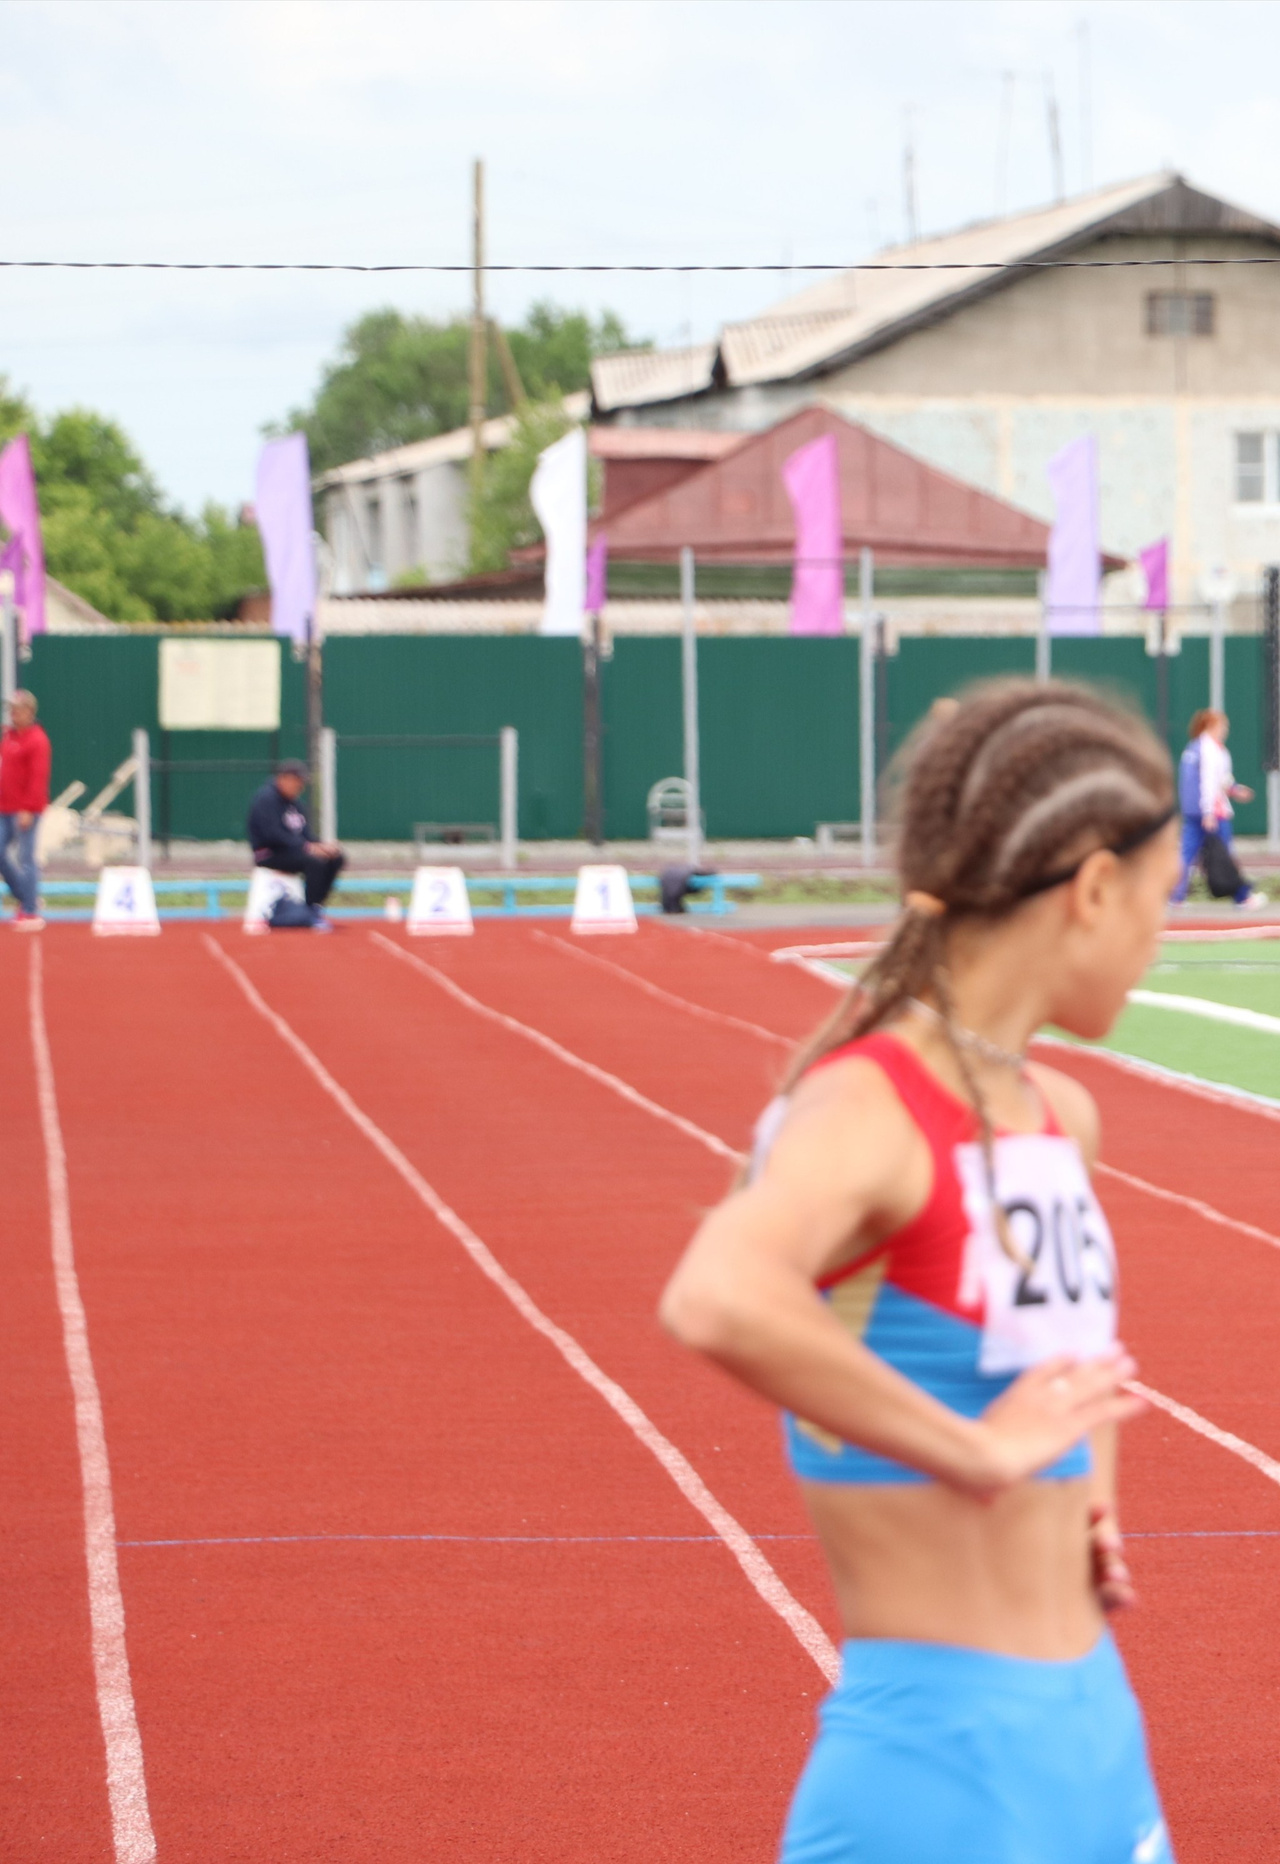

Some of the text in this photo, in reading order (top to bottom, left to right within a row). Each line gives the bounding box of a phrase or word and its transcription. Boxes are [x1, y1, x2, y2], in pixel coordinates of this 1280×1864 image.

[114, 881, 135, 912] 4
[429, 878, 451, 913] 2
[597, 877, 610, 911] 1
